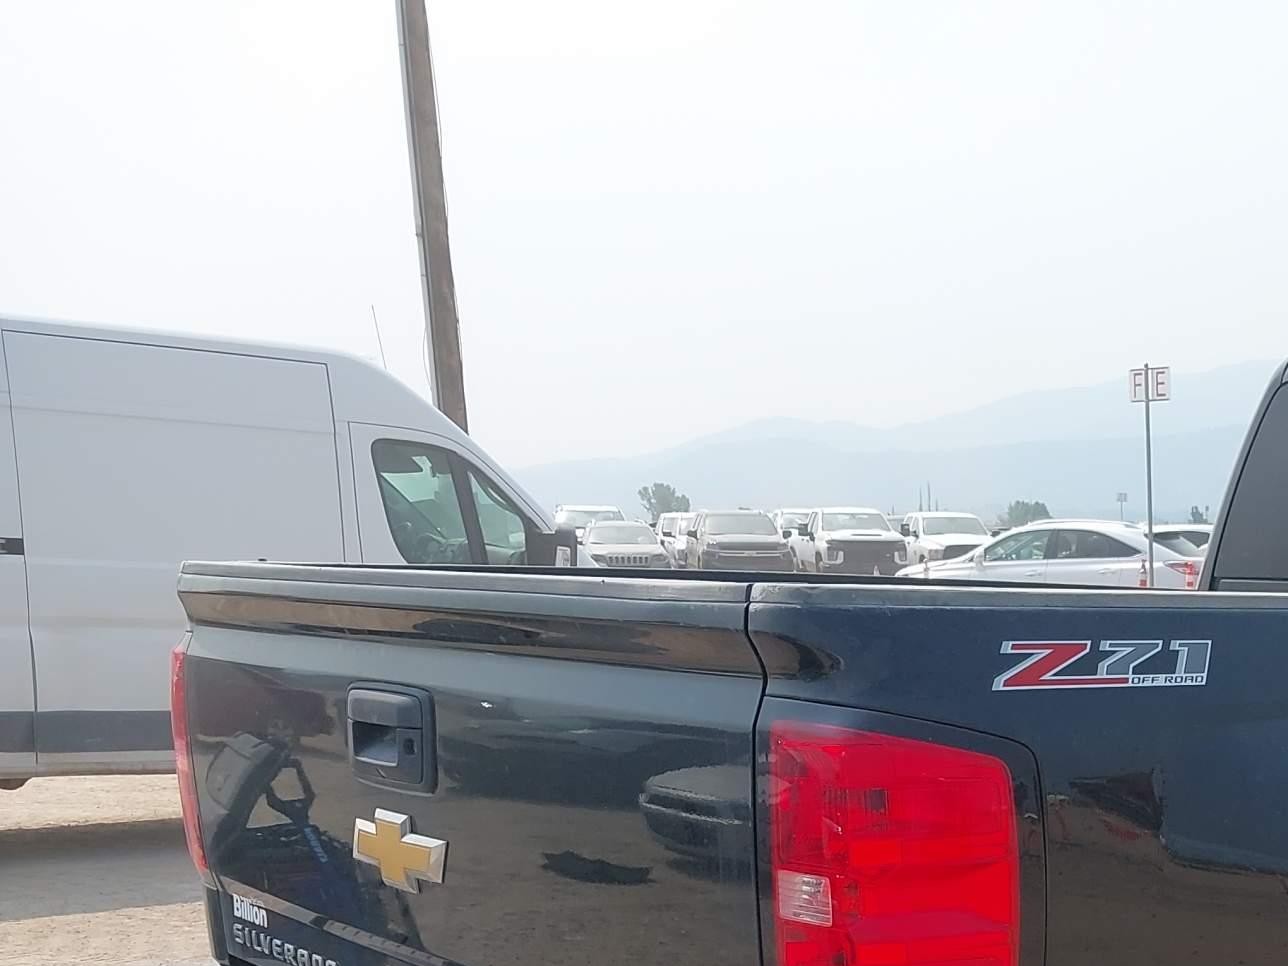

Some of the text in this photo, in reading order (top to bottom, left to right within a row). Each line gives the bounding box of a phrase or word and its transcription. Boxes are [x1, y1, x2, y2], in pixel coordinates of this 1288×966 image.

[1133, 371, 1166, 399] F E
[992, 639, 1212, 691] Z71
[1131, 675, 1204, 685] OFF ROAD
[232, 893, 268, 928] Billion
